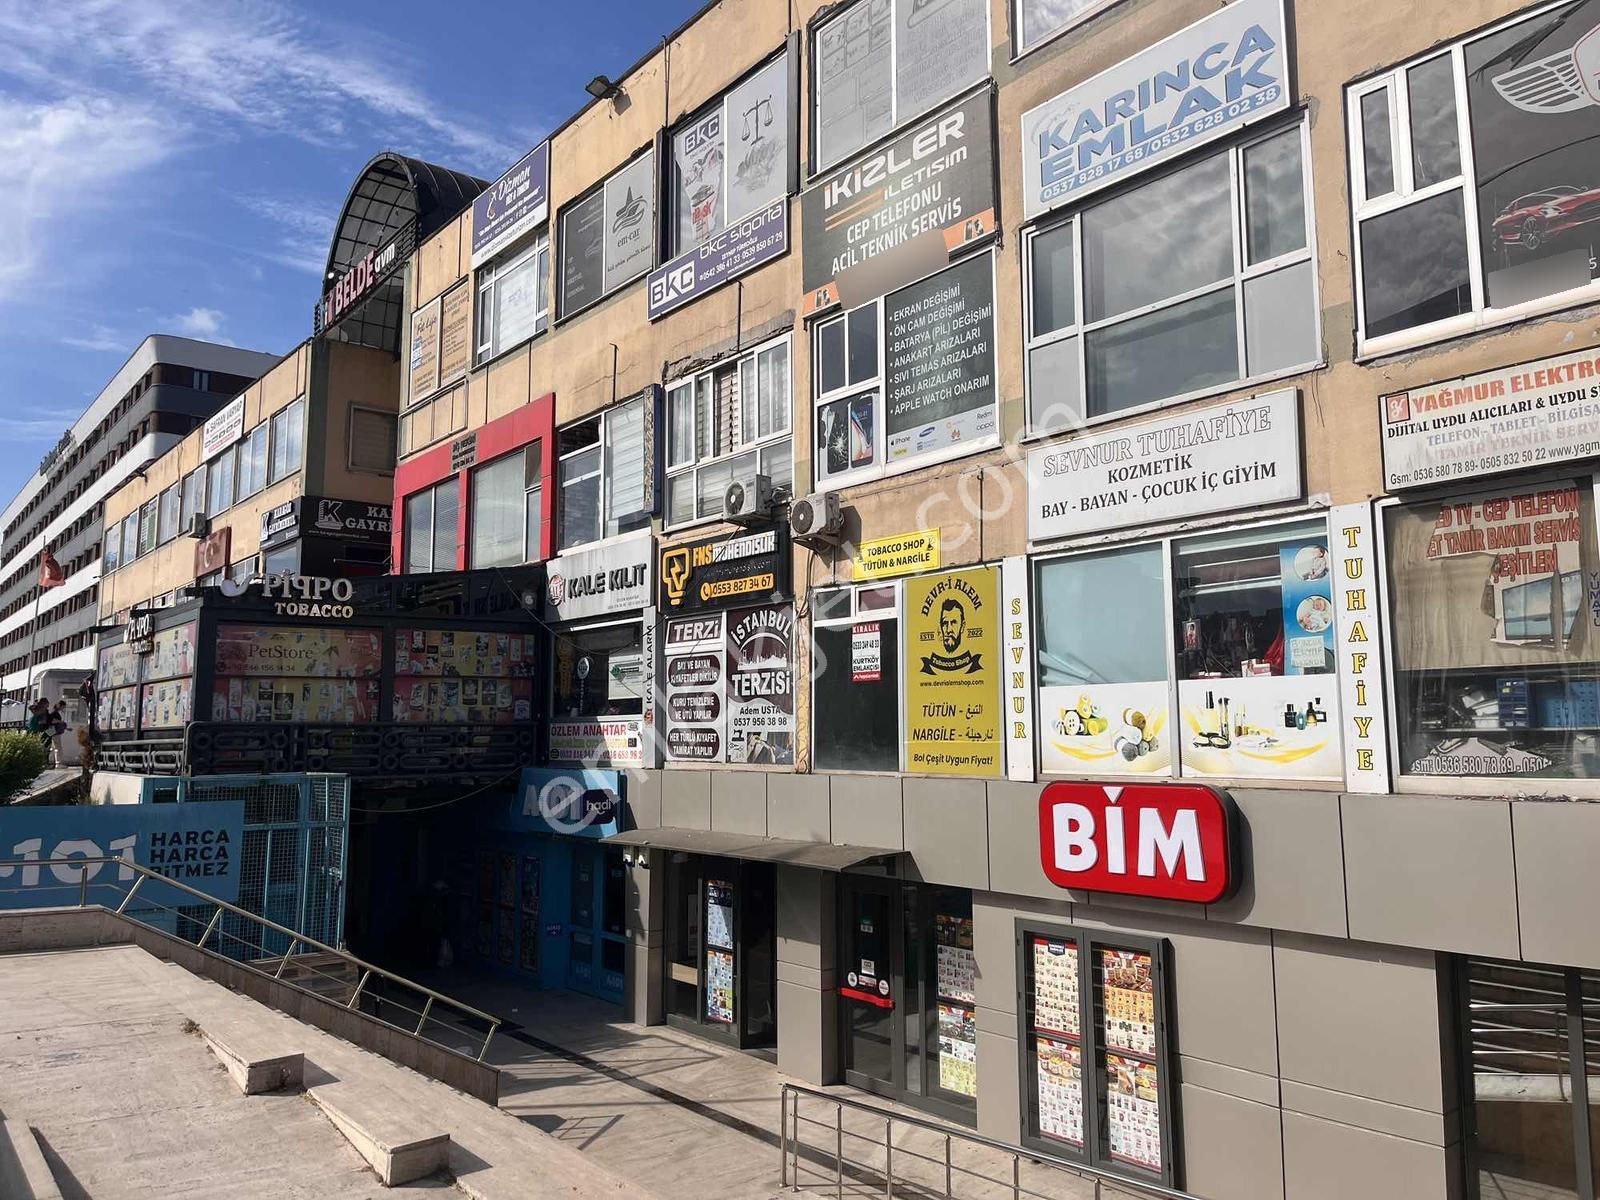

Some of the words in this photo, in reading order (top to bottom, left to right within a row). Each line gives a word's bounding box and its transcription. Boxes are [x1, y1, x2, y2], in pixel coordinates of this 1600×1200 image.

[1038, 24, 1277, 160] KARINCA
[686, 117, 720, 152] BKC
[1040, 50, 1278, 188] EMLAK
[1043, 179, 1075, 200] 0537
[1079, 166, 1104, 184] 828
[1107, 158, 1120, 172] 17
[1193, 111, 1224, 133] 628
[1228, 98, 1251, 119] 02
[1254, 88, 1278, 108] 38
[846, 220, 871, 244] CEP
[872, 181, 942, 231] TELEFONU
[700, 235, 727, 260] bkc
[729, 203, 783, 239] sigorta
[831, 247, 859, 276] ACİL
[860, 223, 908, 258] TEKNİK
[911, 196, 963, 238] SERVİS
[335, 250, 375, 317] BELDE
[374, 242, 397, 273] avm
[651, 262, 695, 309] BKC
[894, 299, 922, 322] EKRAN
[923, 282, 961, 310] DEĞİŞİMİ
[894, 321, 905, 337] ÖN
[907, 314, 926, 333] CAM
[927, 297, 965, 325] DEĞİŞİMİ
[894, 331, 931, 353] BATARYA
[932, 323, 951, 342] (PİL)
[952, 302, 992, 331] DEĞİŞİMİ
[894, 346, 934, 368] ANAKART
[934, 326, 981, 353] ARIZALARI
[894, 369, 910, 384] SIVI
[911, 357, 939, 377] TEMAS
[940, 341, 988, 370] ARIZALARI
[894, 382, 916, 402] ŞARJ
[916, 367, 962, 394] ARIZALARI
[894, 395, 921, 416] APPLE
[922, 385, 952, 407] WATCH
[953, 374, 990, 395] ONARIM
[1412, 378, 1505, 414] YAĞMUR
[1432, 412, 1467, 430] UYDU
[1469, 399, 1532, 423] ALICILARI
[1535, 397, 1546, 410] &
[1548, 388, 1587, 407] UYDU
[1043, 438, 1134, 478] SEVNUR
[1136, 405, 1272, 457] TUHAFİYE
[1427, 427, 1480, 447] TELEFON
[1490, 415, 1537, 436] TABLET
[1107, 453, 1194, 485] KOZMETİK
[1390, 472, 1412, 486] Gsm:
[1413, 467, 1433, 480] 0536
[1435, 464, 1450, 477] 580
[1452, 462, 1463, 474] 78
[1480, 455, 1501, 469] 0505
[1503, 451, 1520, 465] 832
[1522, 449, 1533, 462] 50
[1535, 447, 1547, 460] 22
[1041, 502, 1069, 519] BAY
[1080, 489, 1129, 513] BAYAN
[1141, 476, 1198, 504] ÇOCUK
[1201, 470, 1219, 492] İÇ
[1222, 461, 1277, 486] GİYİM
[1453, 502, 1473, 526] TV
[1482, 497, 1510, 522] CEP
[867, 543, 902, 557] TOBACCO
[903, 538, 925, 551] SHOP
[1487, 521, 1531, 550] BAKIM
[1534, 511, 1581, 544] SERVİS
[862, 558, 888, 572] TÜTÜN
[889, 559, 895, 567] &
[895, 552, 931, 567] NARGİLE
[1491, 543, 1559, 584] ÇEŞİTLERİ
[568, 572, 606, 600] KALE
[713, 582, 732, 595] 0553
[733, 579, 747, 592] 827
[749, 578, 759, 589] 34
[761, 575, 772, 588] 67
[954, 578, 983, 611] ALEM
[274, 602, 354, 619] TOBACCO
[730, 610, 792, 645] İSTANBUL
[674, 620, 719, 642] TERZİ
[967, 629, 983, 638] 2022
[1342, 526, 1374, 771] TUHAFİYE
[248, 643, 314, 660] PetStore
[1011, 597, 1027, 739] SEVNUR
[732, 671, 790, 697] TERZİSİ
[734, 717, 751, 727] 0537
[752, 717, 765, 726] 956
[767, 717, 777, 726] 38
[778, 717, 787, 726] 98
[739, 706, 760, 715] Adem
[761, 705, 781, 715] USTA
[922, 704, 957, 718] TÜTÜN
[582, 723, 626, 736] ANAHTAR
[912, 725, 956, 742] NARGİLE
[913, 753, 925, 763] Bol
[925, 753, 945, 765] Çeşit
[945, 755, 970, 767] Uygun
[971, 755, 993, 766] Fiyat!
[1434, 756, 1460, 773] 0536
[1461, 756, 1481, 773] 580
[1484, 756, 1497, 773] 78
[1499, 756, 1513, 773] 89
[586, 799, 612, 812] hadi
[151, 829, 230, 847] HARCA
[1051, 786, 1207, 882] BİM
[150, 846, 229, 864] HARCA
